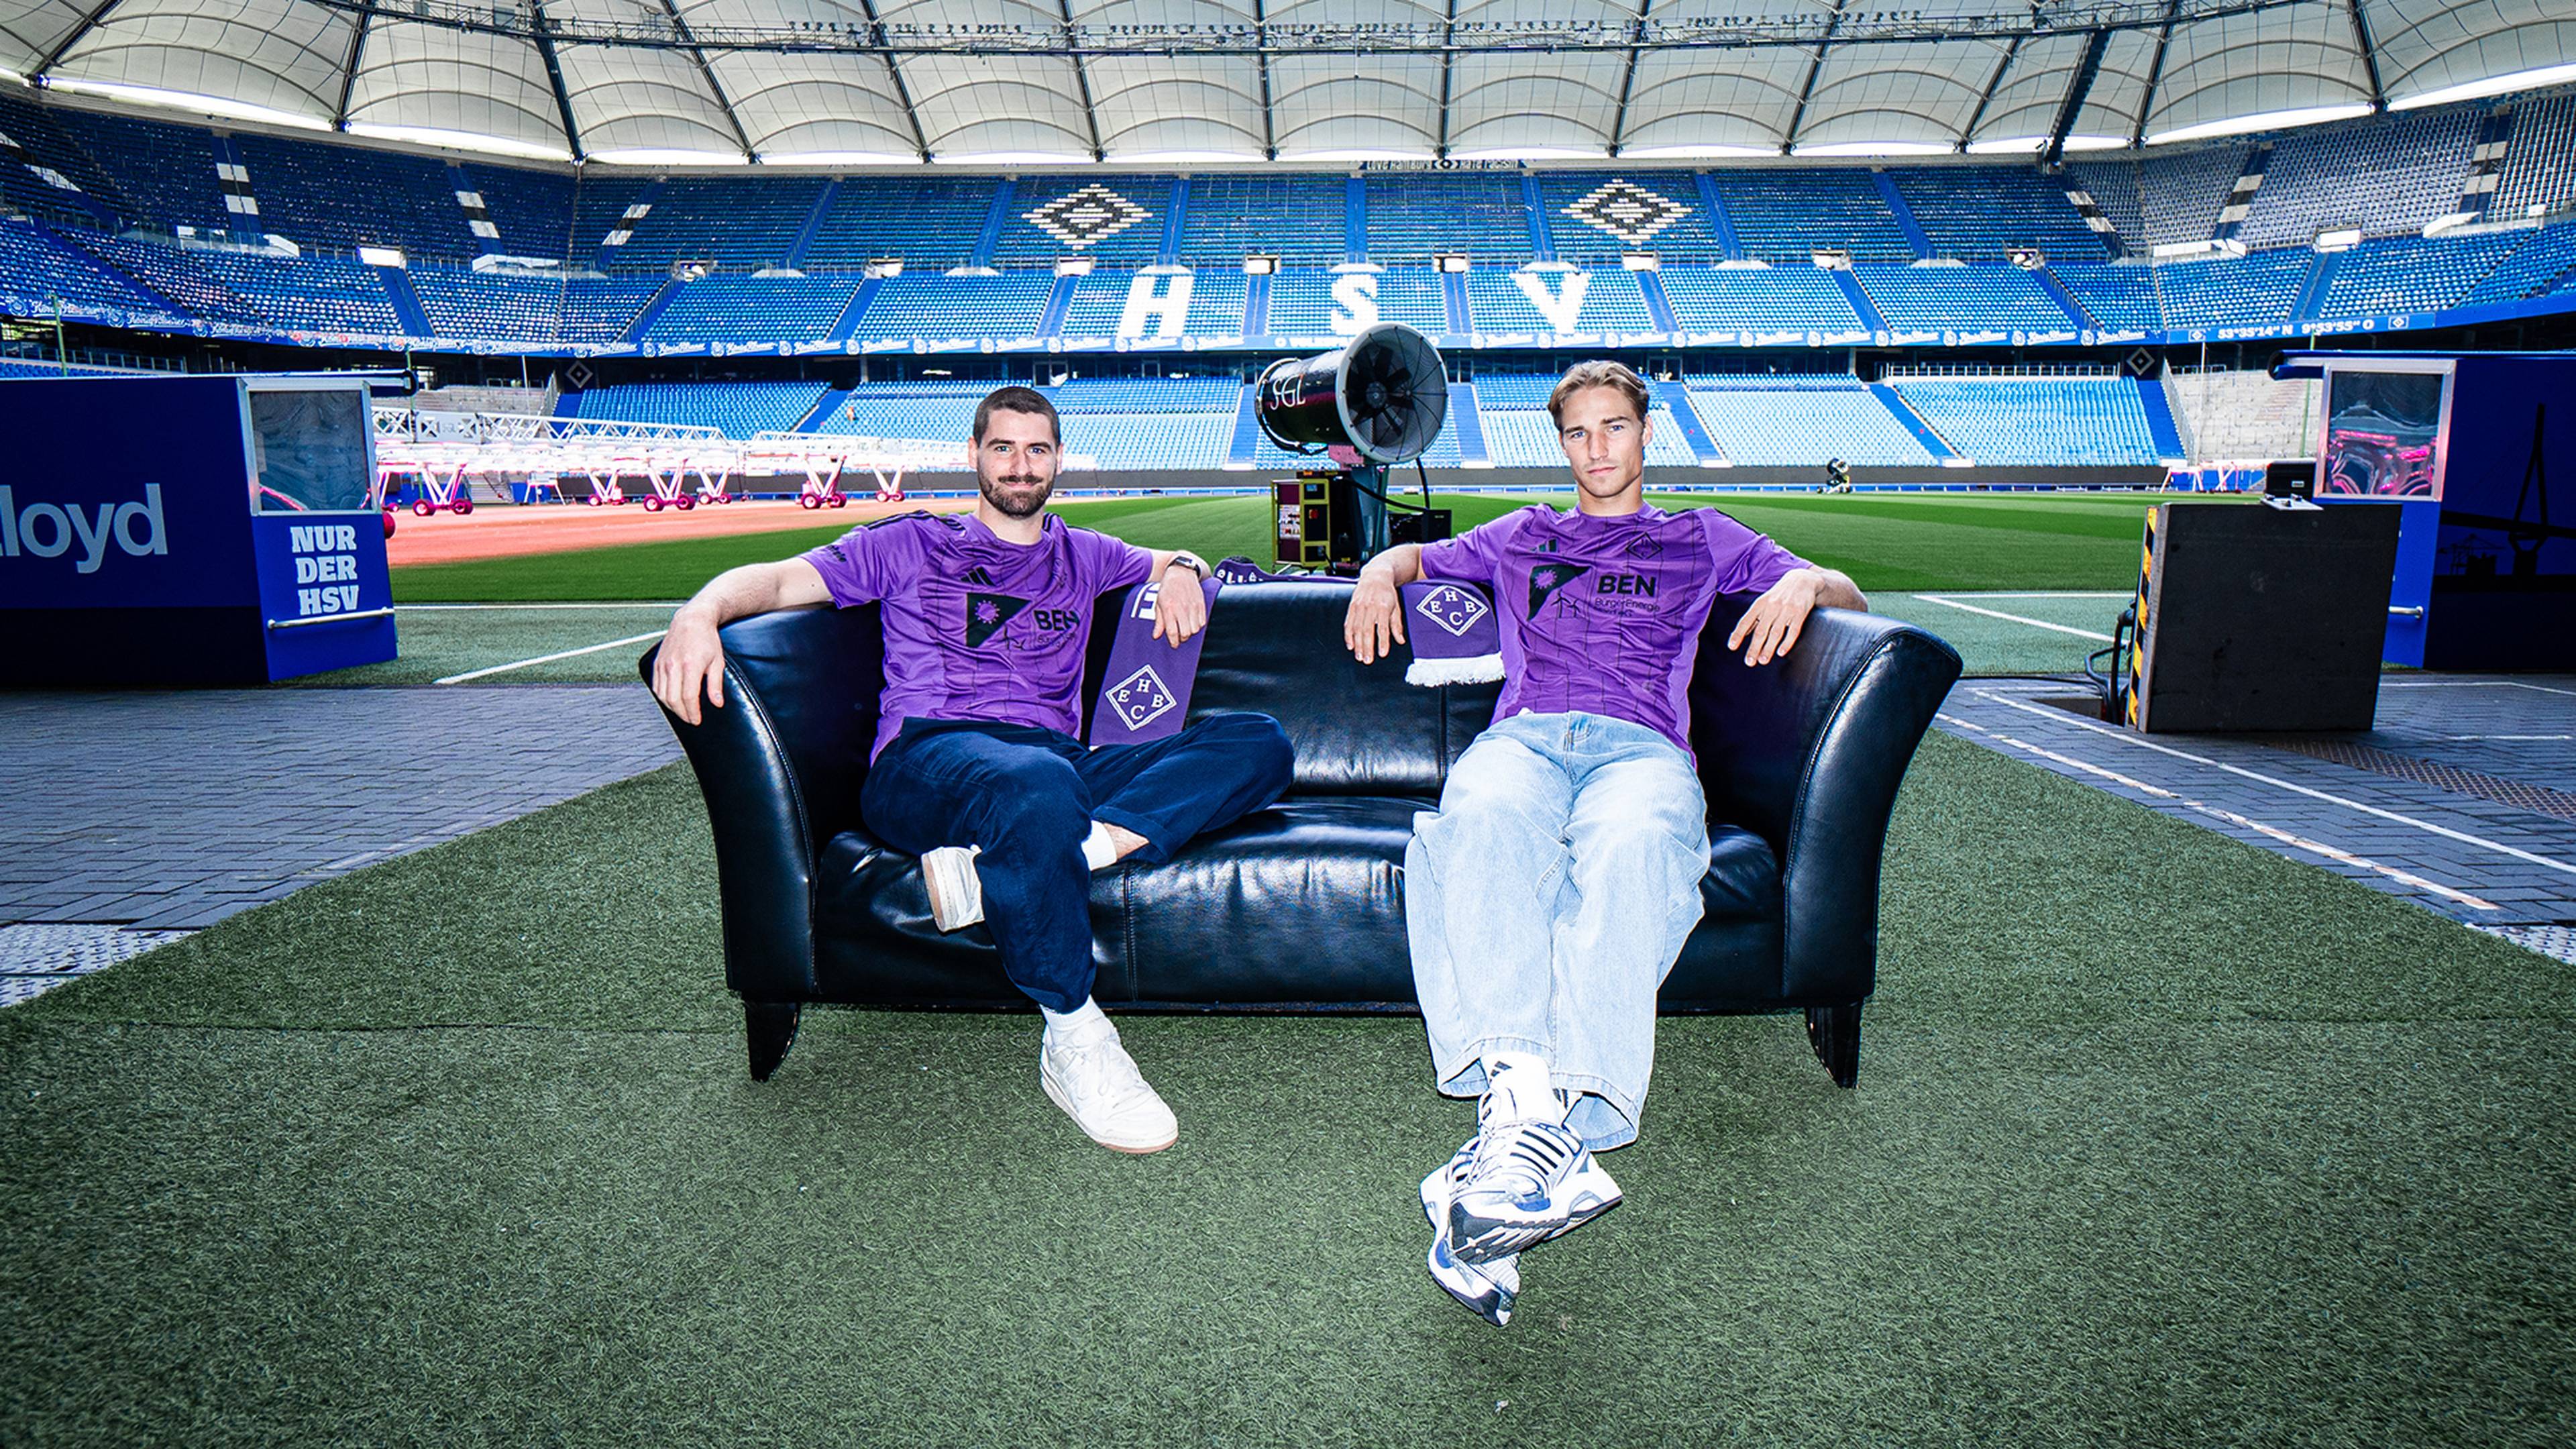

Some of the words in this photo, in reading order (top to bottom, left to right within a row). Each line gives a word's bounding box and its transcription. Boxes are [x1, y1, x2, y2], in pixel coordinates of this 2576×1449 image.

[2282, 325, 2294, 335] N
[1270, 374, 1306, 410] SGL
[0, 483, 168, 574] loyd
[290, 525, 357, 553] NUR
[295, 555, 358, 584] DER
[297, 585, 360, 616] HSV
[1598, 575, 1656, 597] BEN
